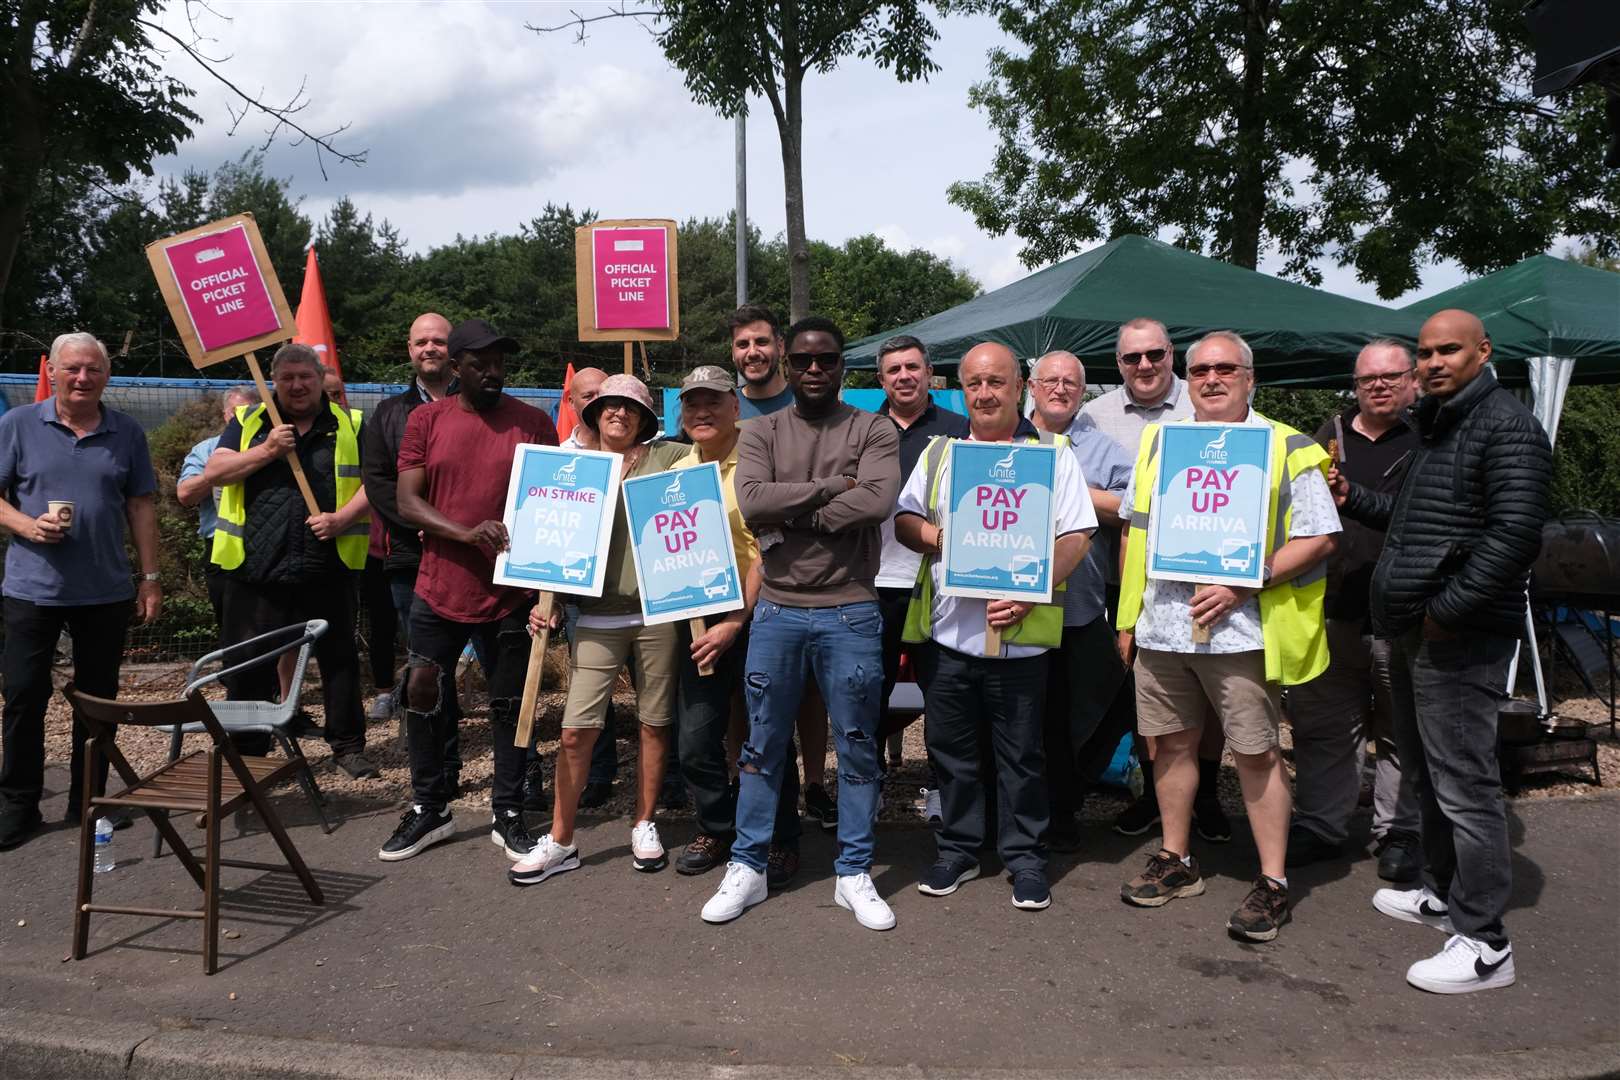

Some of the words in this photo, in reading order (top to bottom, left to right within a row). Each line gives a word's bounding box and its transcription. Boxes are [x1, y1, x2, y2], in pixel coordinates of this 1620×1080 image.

[191, 266, 249, 291] OFFICIAL
[604, 263, 657, 275] OFFICIAL
[202, 281, 246, 304] PICKET
[611, 277, 652, 288] PICKET
[215, 298, 245, 316] LINE
[618, 291, 645, 302] LINE
[1199, 449, 1228, 460] unite
[552, 471, 577, 483] unite
[988, 468, 1016, 479] unite
[1186, 468, 1240, 490] PAY
[528, 486, 548, 498] ON
[551, 488, 597, 504] STRIKE
[660, 491, 686, 504] unite
[976, 486, 1028, 508] PAY
[1192, 491, 1230, 513] UP
[534, 507, 582, 529] FAIR
[654, 507, 699, 534] PAY
[982, 509, 1019, 531] UP
[1170, 513, 1248, 534] ARRIVA
[535, 527, 576, 549] PAY
[664, 531, 698, 553] UP
[962, 531, 1035, 550] ARRIVA
[653, 548, 719, 574] ARRIVA
